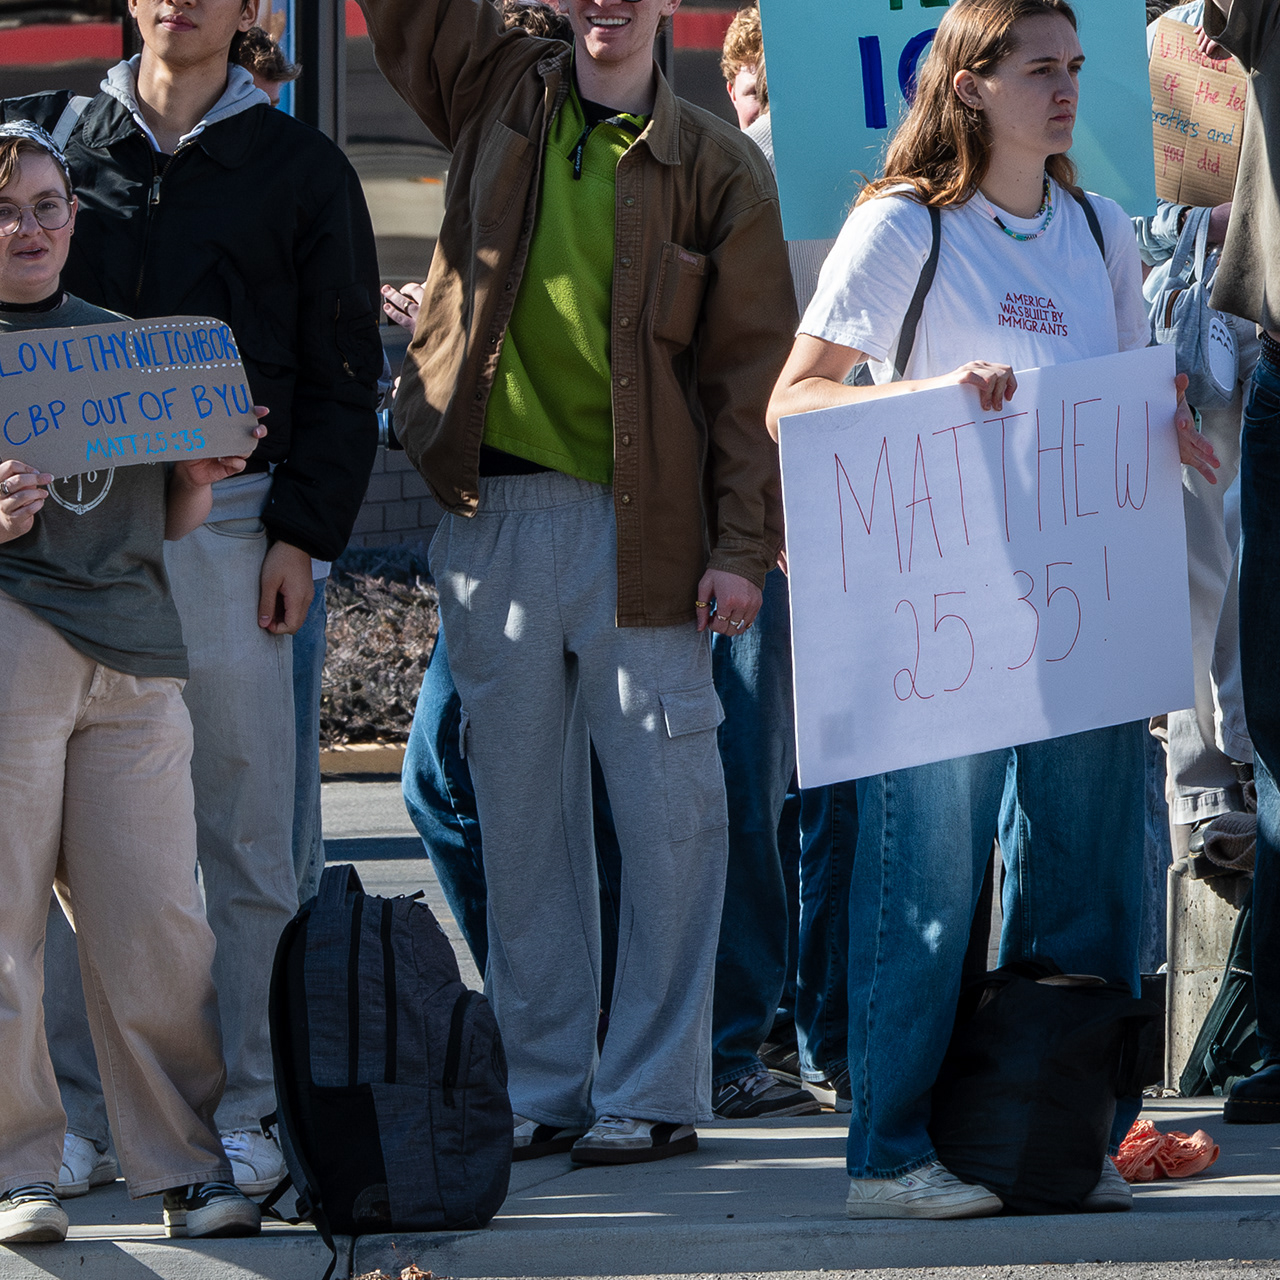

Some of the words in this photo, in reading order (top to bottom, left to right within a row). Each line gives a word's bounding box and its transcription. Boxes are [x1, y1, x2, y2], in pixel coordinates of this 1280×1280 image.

[1160, 32, 1230, 73] Whaever
[1195, 81, 1220, 104] the
[1207, 124, 1235, 145] and
[1163, 144, 1185, 176] you
[1197, 149, 1221, 177] did
[1000, 302, 1024, 318] WAS
[1024, 305, 1051, 322] BUILT
[1051, 310, 1064, 325] BY
[1005, 292, 1056, 310] AMERICA
[998, 313, 1068, 337] IMMIGRANTS
[0, 339, 83, 377] LOVE
[83, 331, 132, 372] THY
[133, 325, 239, 368] NEIGHBOR
[3, 400, 66, 446] CBP
[82, 392, 131, 427] OUT
[138, 388, 177, 421] OF
[191, 383, 250, 420] BYU
[86, 434, 138, 462] MATT
[143, 428, 206, 455] 25:35
[834, 398, 1149, 593] MATTHEW
